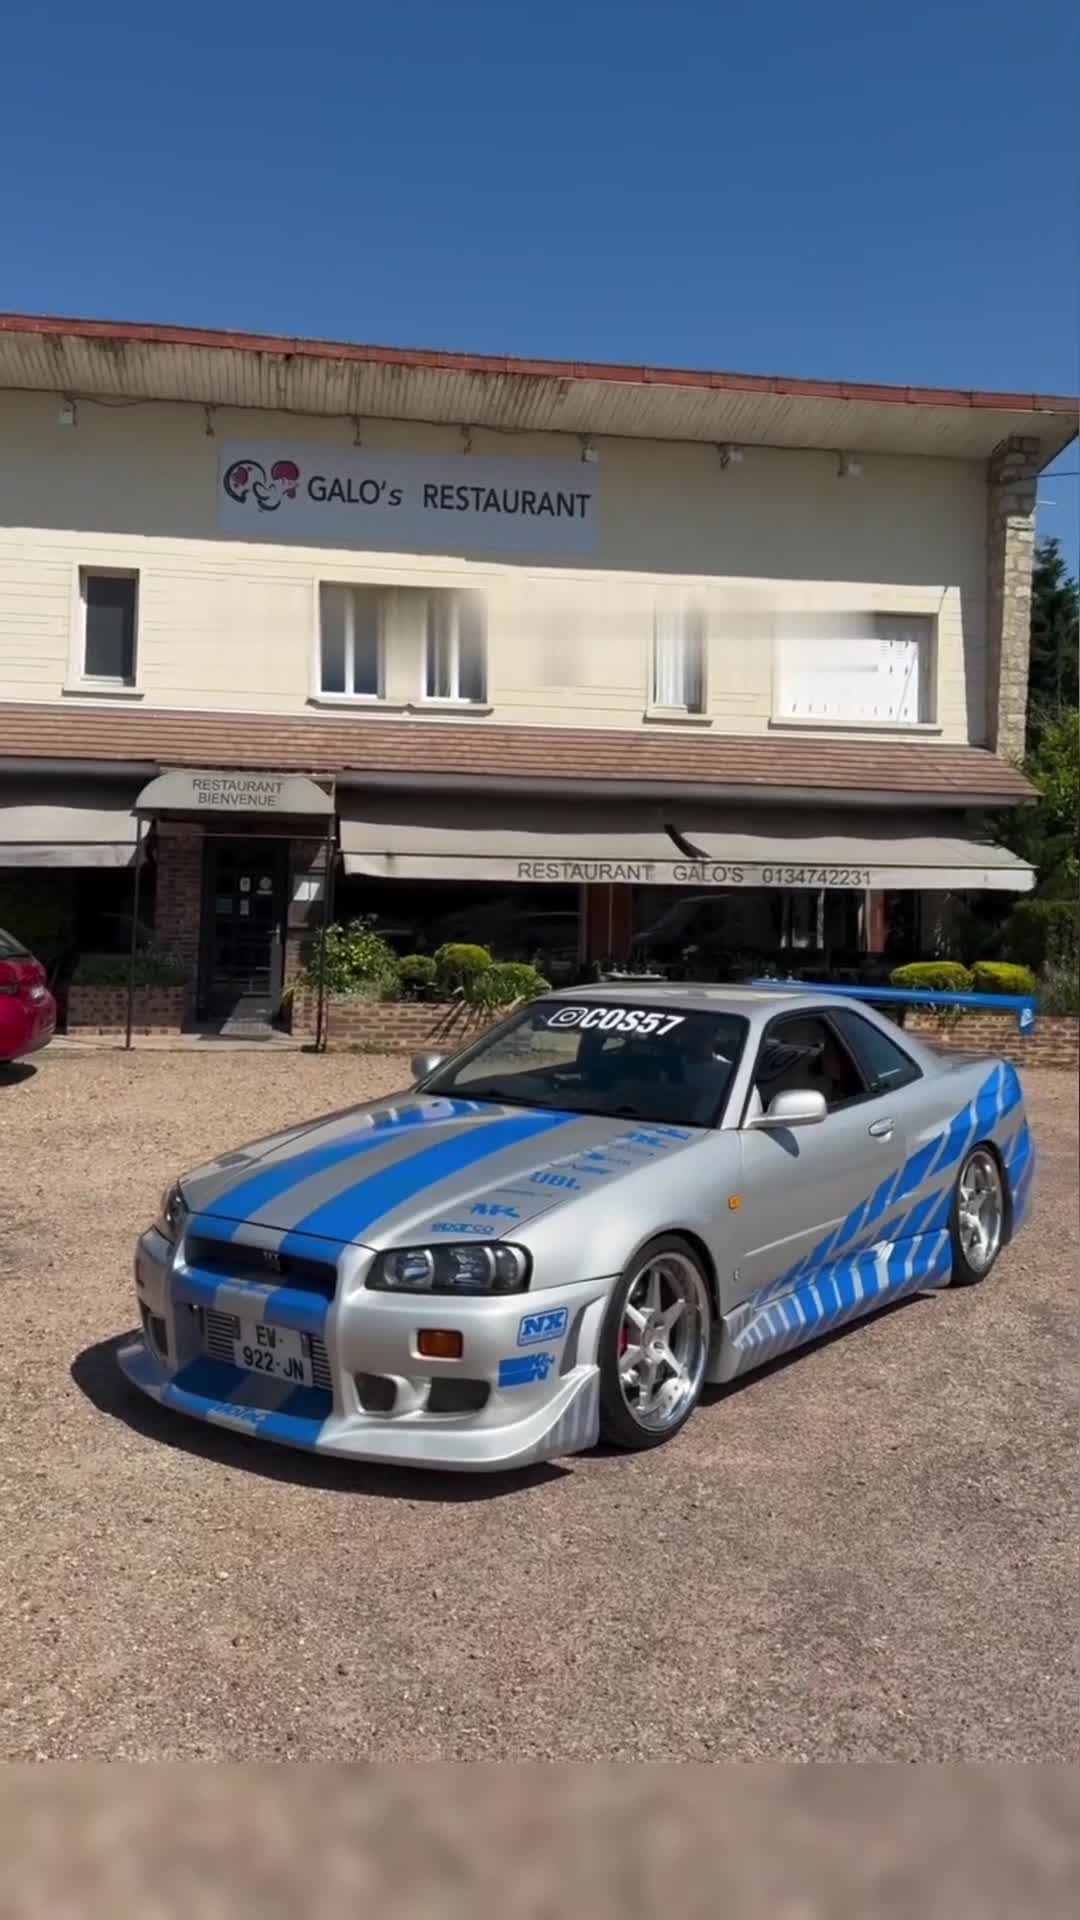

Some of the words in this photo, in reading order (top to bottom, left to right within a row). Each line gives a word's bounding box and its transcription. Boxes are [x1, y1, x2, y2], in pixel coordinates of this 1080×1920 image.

[307, 475, 402, 507] GALO's
[423, 484, 591, 519] RESTAURANT
[192, 778, 285, 794] RESTAURANT
[198, 791, 277, 807] BIENVENUE
[517, 861, 655, 882] RESTAURANT
[672, 865, 745, 884] GALO'S
[761, 867, 872, 887] 0134742231
